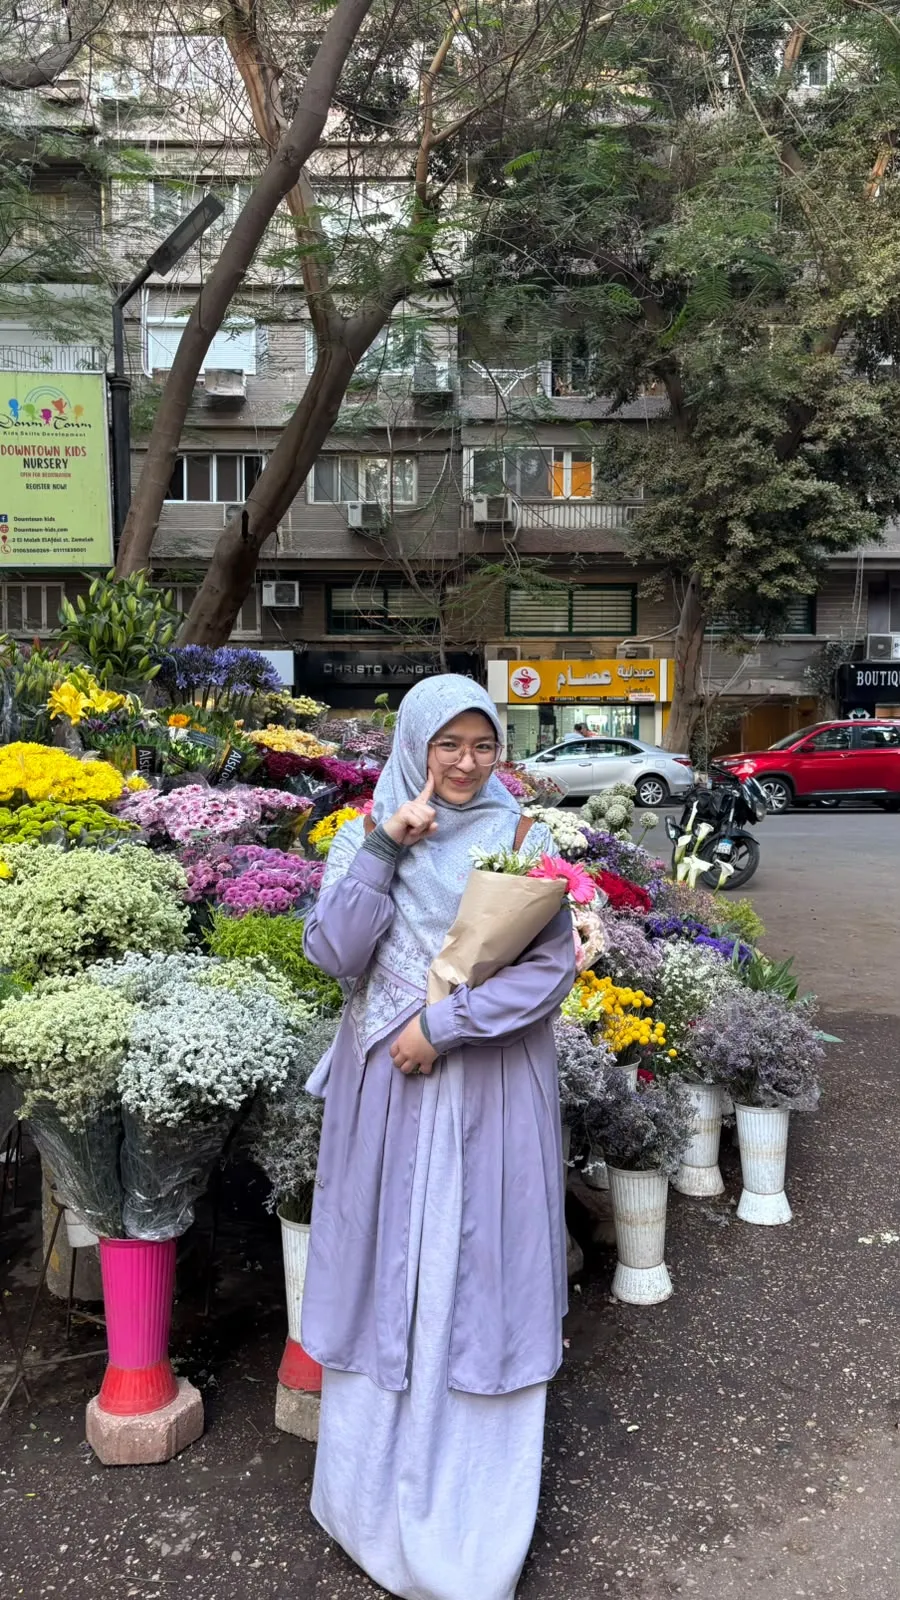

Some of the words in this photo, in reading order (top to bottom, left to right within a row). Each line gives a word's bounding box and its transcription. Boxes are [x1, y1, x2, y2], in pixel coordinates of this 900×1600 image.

[0, 444, 60, 457] DOWNTOWN
[65, 445, 87, 457] KIDS
[23, 457, 69, 469] NURSERY
[323, 663, 383, 674] CHRISTO
[617, 664, 656, 682] صيدلية
[557, 664, 612, 693] عصام
[857, 671, 900, 688] BOUTIQ
